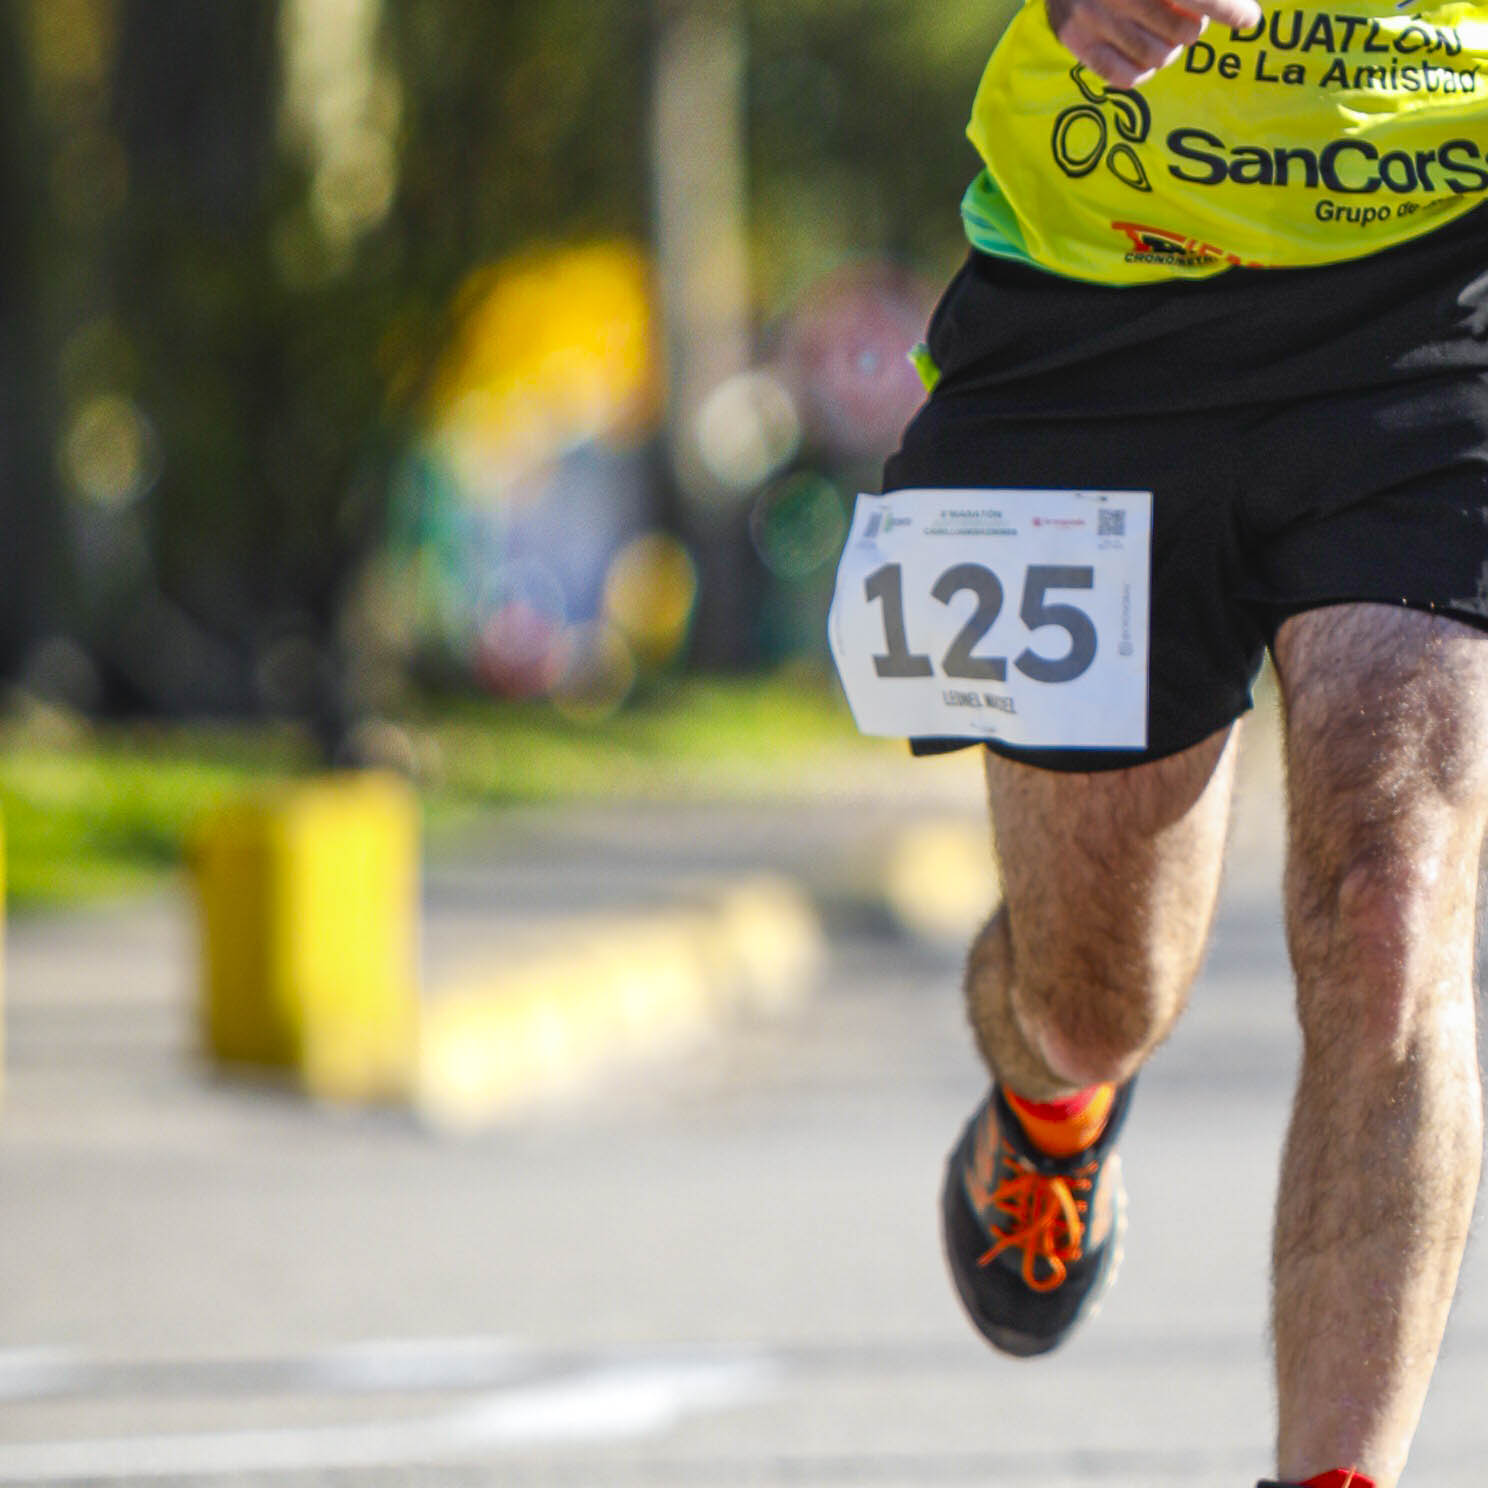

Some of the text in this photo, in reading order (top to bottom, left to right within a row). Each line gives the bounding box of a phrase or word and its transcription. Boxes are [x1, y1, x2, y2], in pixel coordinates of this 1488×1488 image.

[1184, 40, 1242, 79] De
[1254, 50, 1306, 86] La
[1315, 199, 1391, 228] Grupo
[864, 562, 1098, 684] 125
